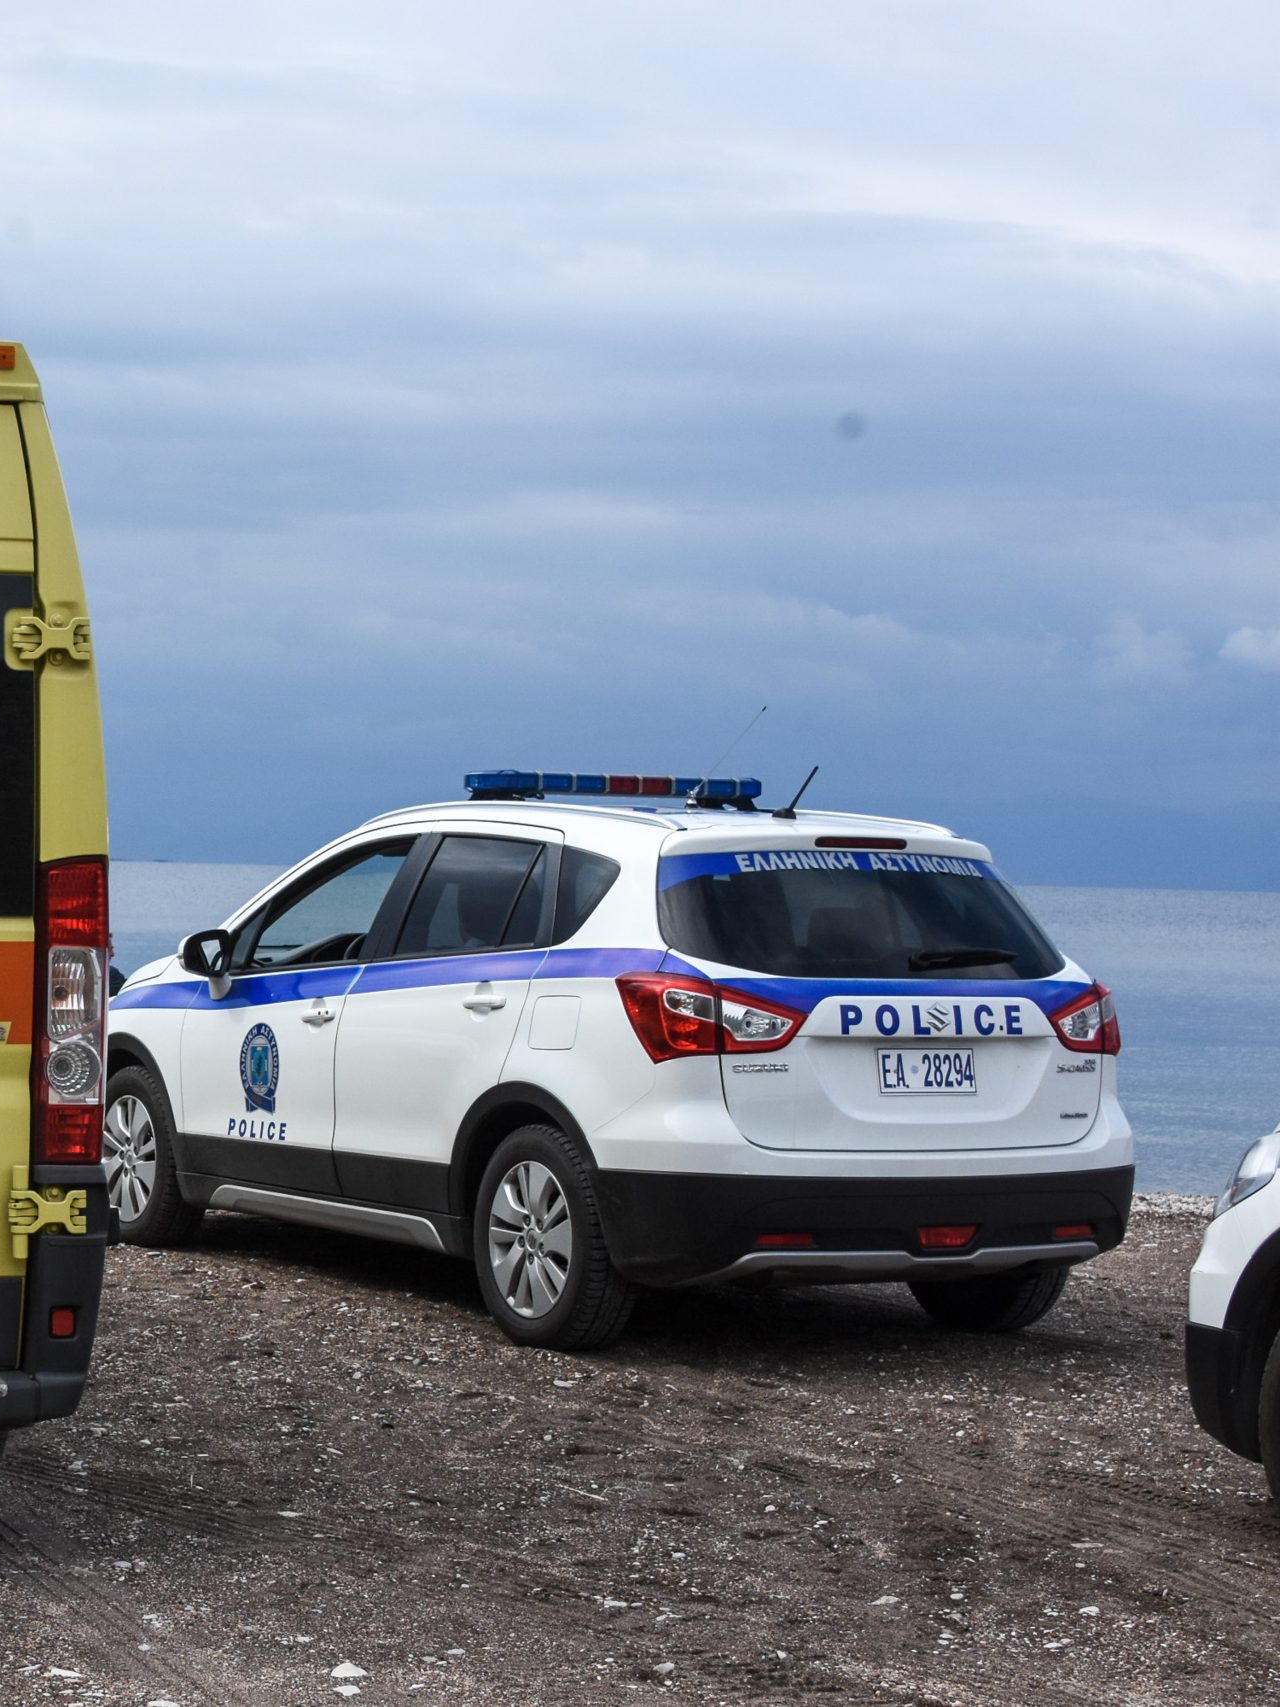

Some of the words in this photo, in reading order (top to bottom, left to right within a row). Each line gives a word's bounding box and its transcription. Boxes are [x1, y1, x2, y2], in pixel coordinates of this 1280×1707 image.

[734, 851, 860, 873] ΕΛΛΗΝΙΚΗ
[868, 853, 984, 879] ΑΣΤΥΝΟΜΙΑ
[839, 1003, 1024, 1037] POLICE
[921, 1053, 974, 1088] 28294
[227, 1118, 287, 1141] POLICE
